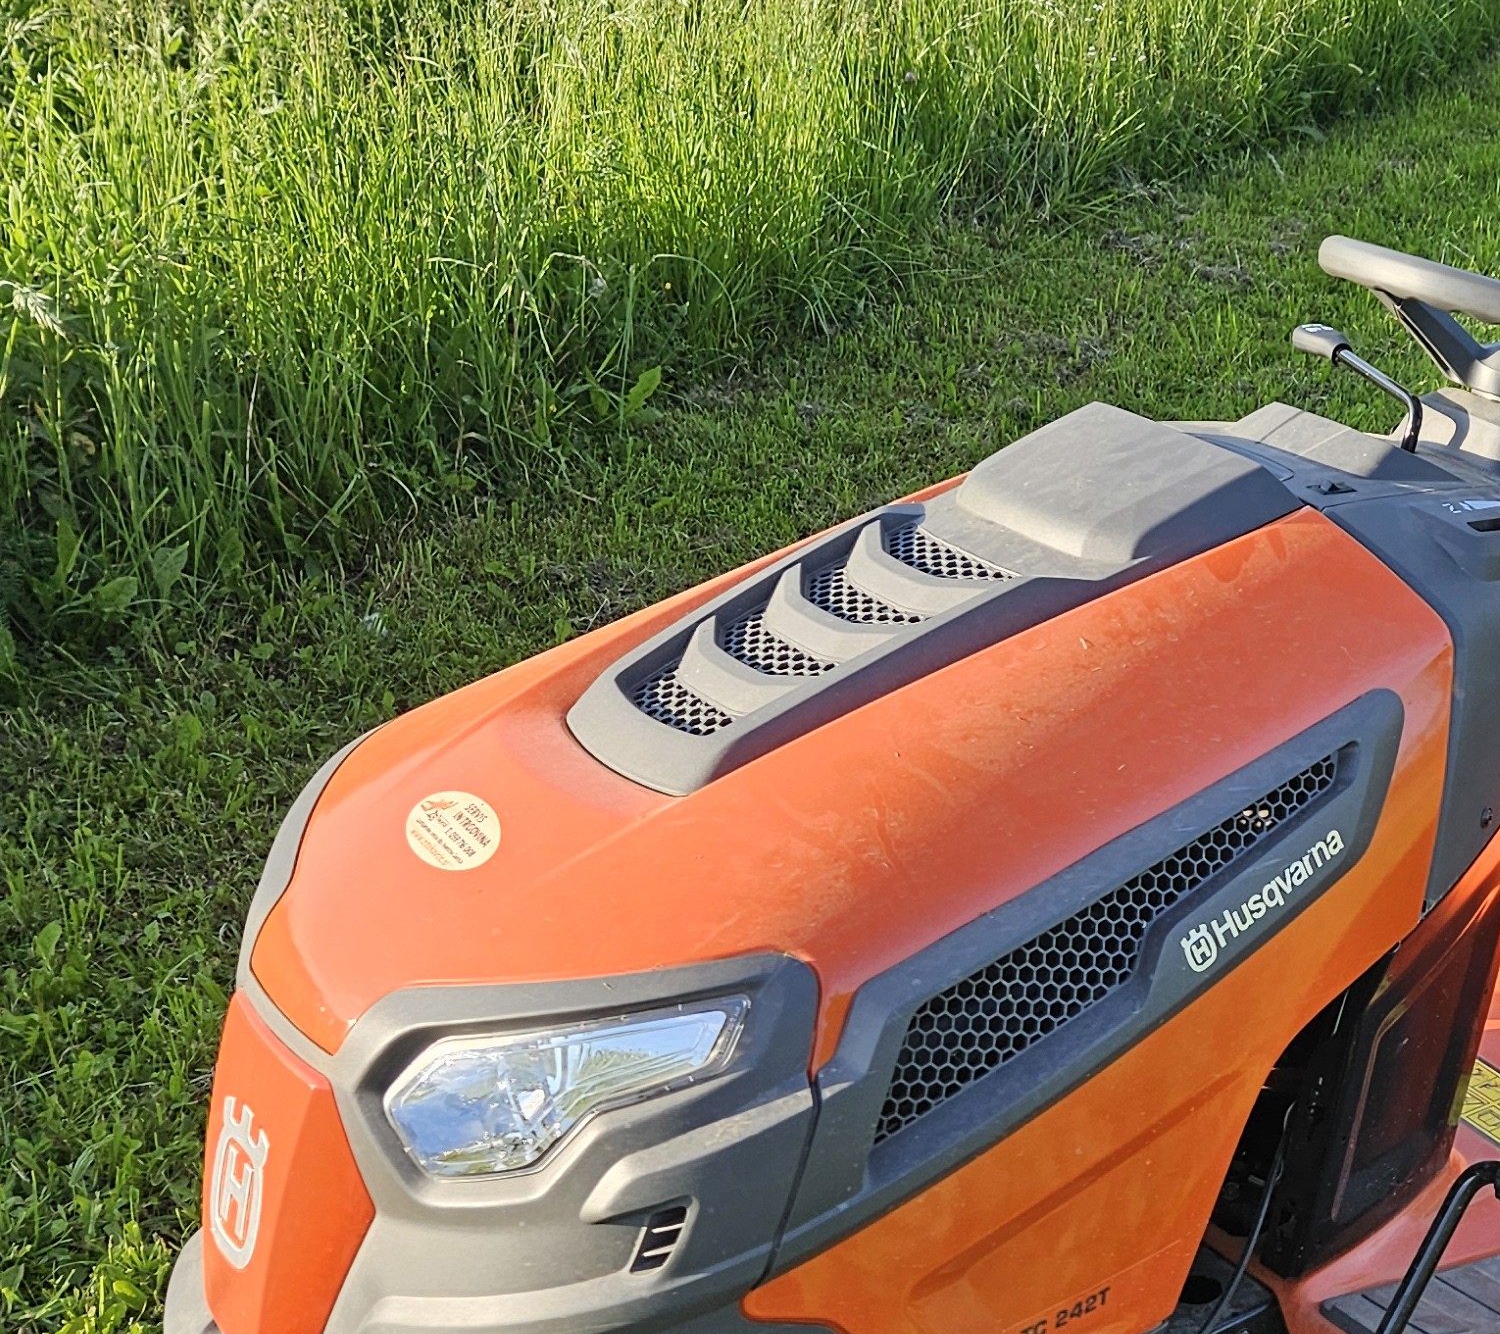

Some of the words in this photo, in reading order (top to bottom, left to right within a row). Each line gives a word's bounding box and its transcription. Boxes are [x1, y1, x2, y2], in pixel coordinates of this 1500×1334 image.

[464, 803, 488, 823] SERVIS
[459, 816, 491, 848] TRGOVINA
[1210, 829, 1345, 948] Husqvarna
[1055, 1286, 1111, 1329] 242T
